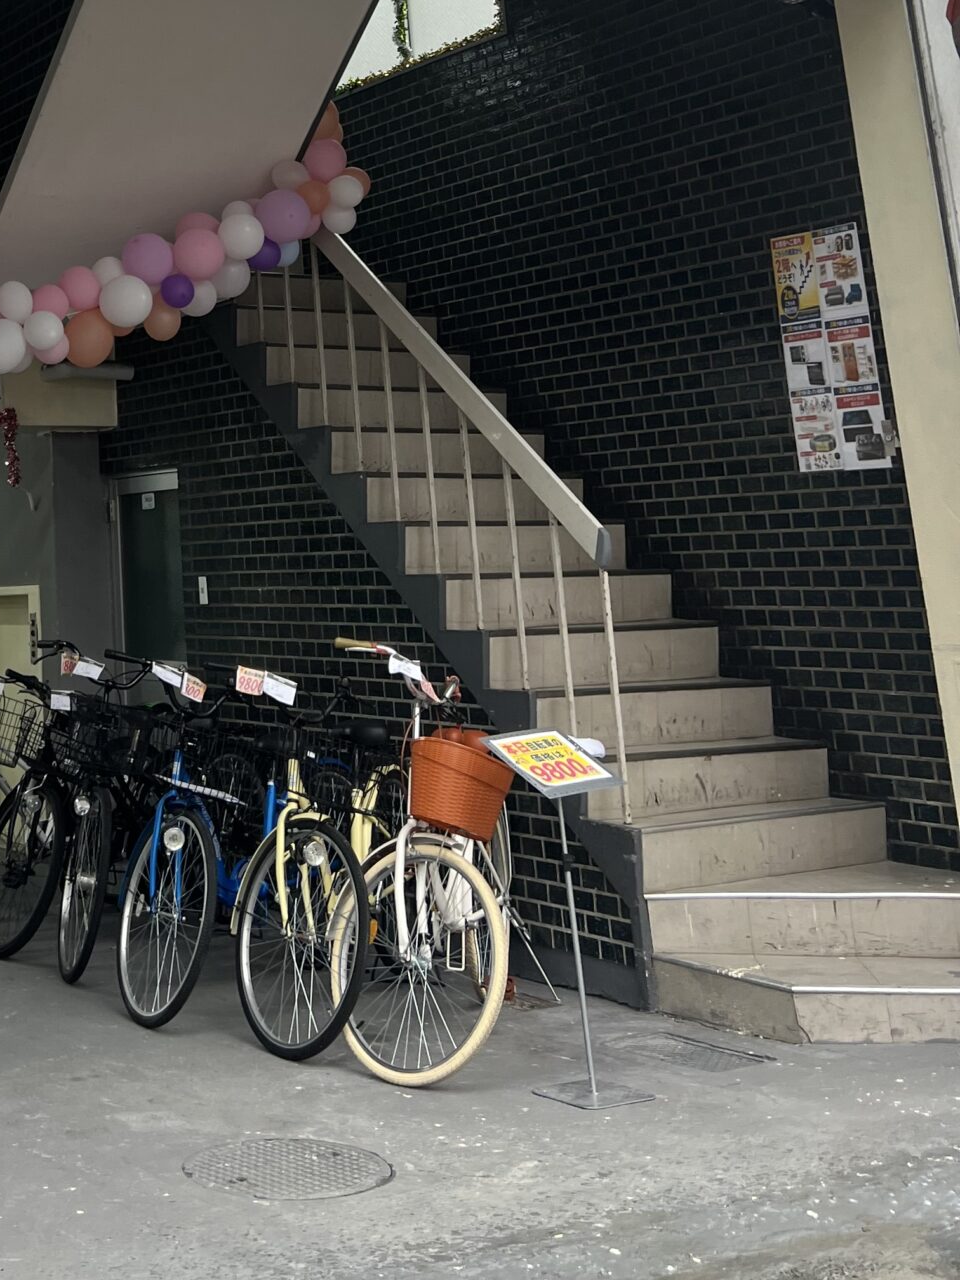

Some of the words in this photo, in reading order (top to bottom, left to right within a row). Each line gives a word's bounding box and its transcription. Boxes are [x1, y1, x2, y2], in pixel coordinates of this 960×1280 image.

[502, 738, 563, 754] 本日自転車の
[531, 751, 565, 762] 価格は
